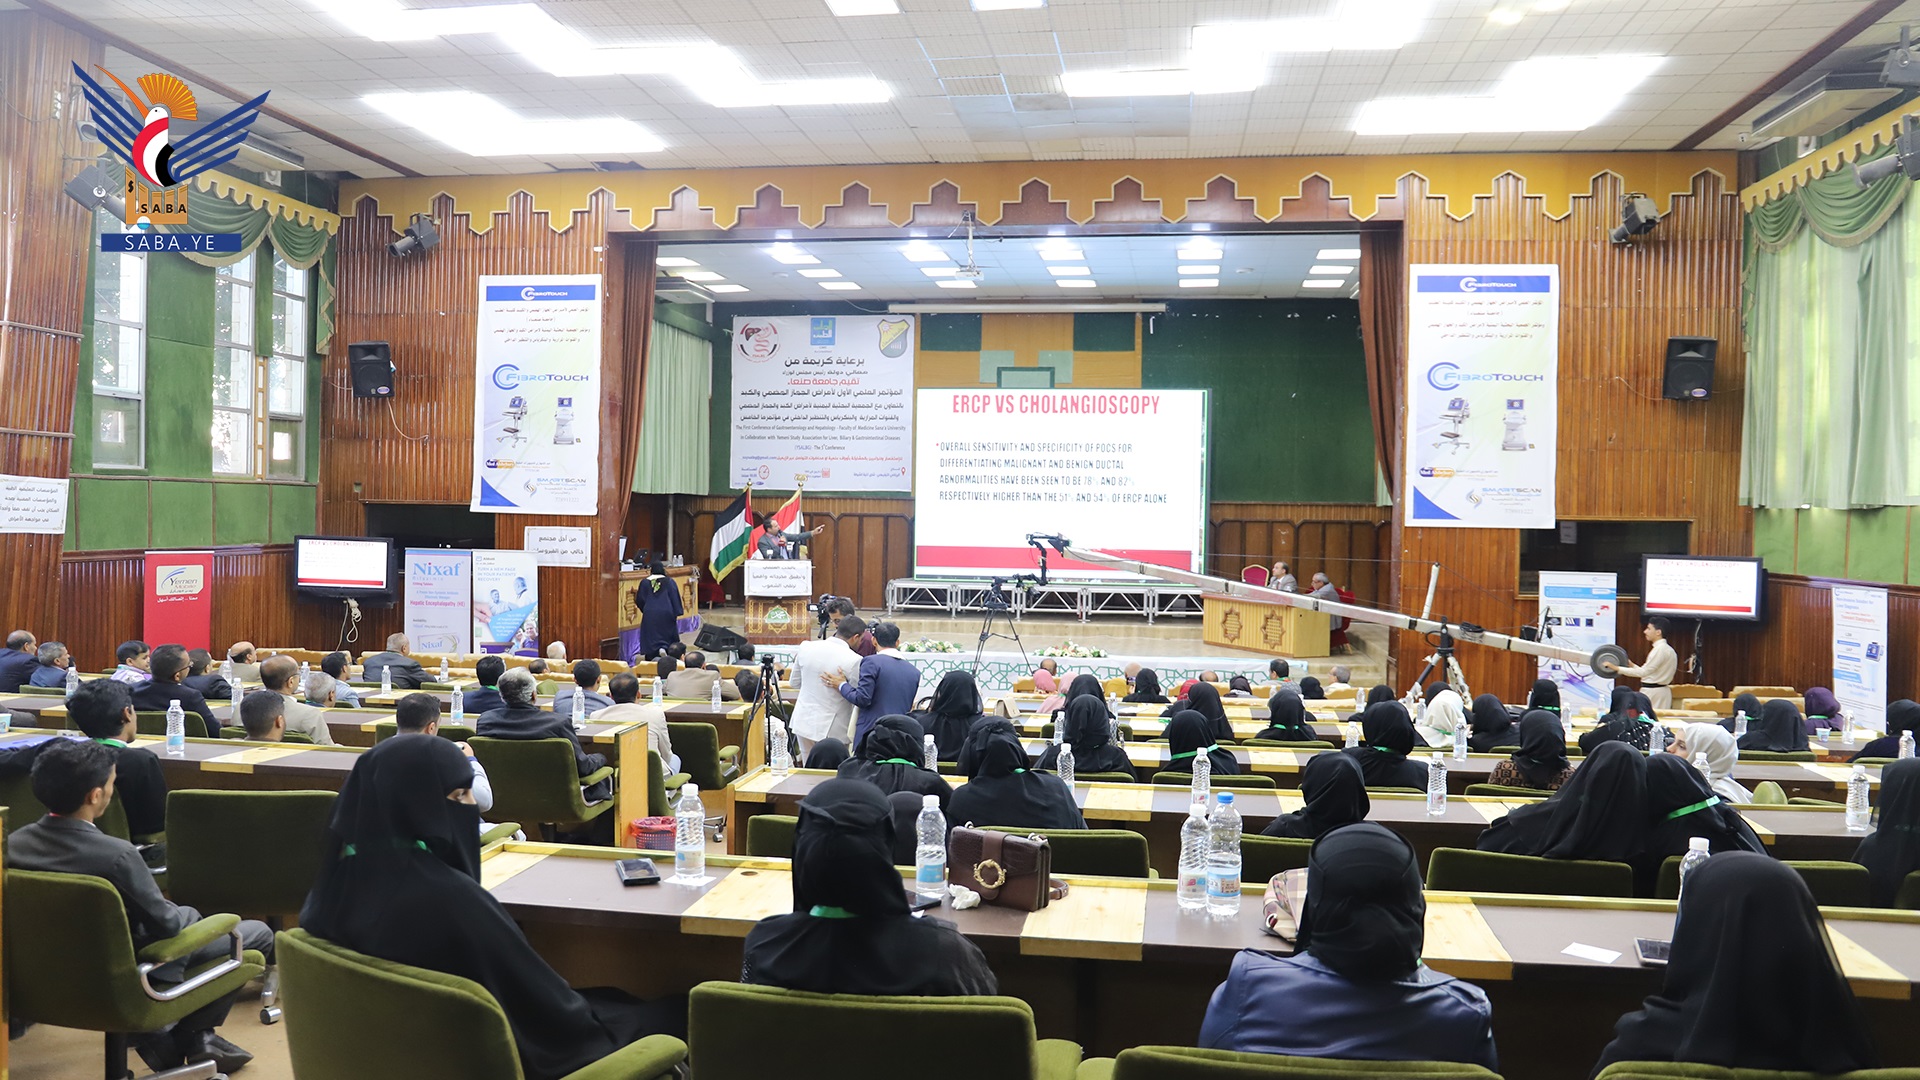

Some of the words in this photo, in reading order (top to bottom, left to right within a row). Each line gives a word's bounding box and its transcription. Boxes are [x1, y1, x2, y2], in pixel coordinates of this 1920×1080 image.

[784, 356, 800, 366] من
[802, 356, 833, 366] كريمة
[836, 356, 865, 366] برعاية
[812, 378, 838, 386] جامعة
[839, 378, 860, 386] تقيم
[1444, 373, 1543, 381] FIBROTOUCH
[953, 395, 990, 413] ERCP
[996, 395, 1014, 413] VS
[1020, 395, 1160, 413] CHOLANGIOSCOPY
[940, 442, 971, 452] OVERALL
[973, 442, 1018, 452] SENSITIVITY
[1020, 443, 1036, 452] AND
[1037, 443, 1083, 452] SPECIFICITY
[1085, 443, 1094, 453] OF
[1096, 443, 1116, 453] POCS
[1118, 443, 1132, 453] FOR
[940, 458, 1002, 468] DIFFERENTIATING
[1004, 459, 1046, 468] MALIGNANT
[1049, 459, 1064, 469] AND
[1066, 459, 1094, 469] BENIGN
[1096, 459, 1124, 469] DUCTAL
[940, 475, 998, 484] ABNORMALITIES
[1001, 475, 1019, 485] HAVE
[1021, 476, 1039, 485] BEEN
[1041, 476, 1059, 485] SEEN
[1061, 476, 1070, 485] TO
[1072, 476, 1081, 485] BE
[1101, 476, 1116, 485] AND
[940, 491, 990, 501] RESPECTIVELY
[993, 492, 1020, 501] HIGHER
[1023, 492, 1042, 502] THAN
[1044, 492, 1057, 502] THE
[1076, 492, 1092, 502] AND
[1112, 492, 1121, 502] OF
[1122, 492, 1142, 502] ERCP
[1144, 493, 1167, 502] ALONE
[413, 562, 461, 576] Nixaf
[170, 577, 198, 586] Yemen
[422, 641, 443, 650] Nixaf
